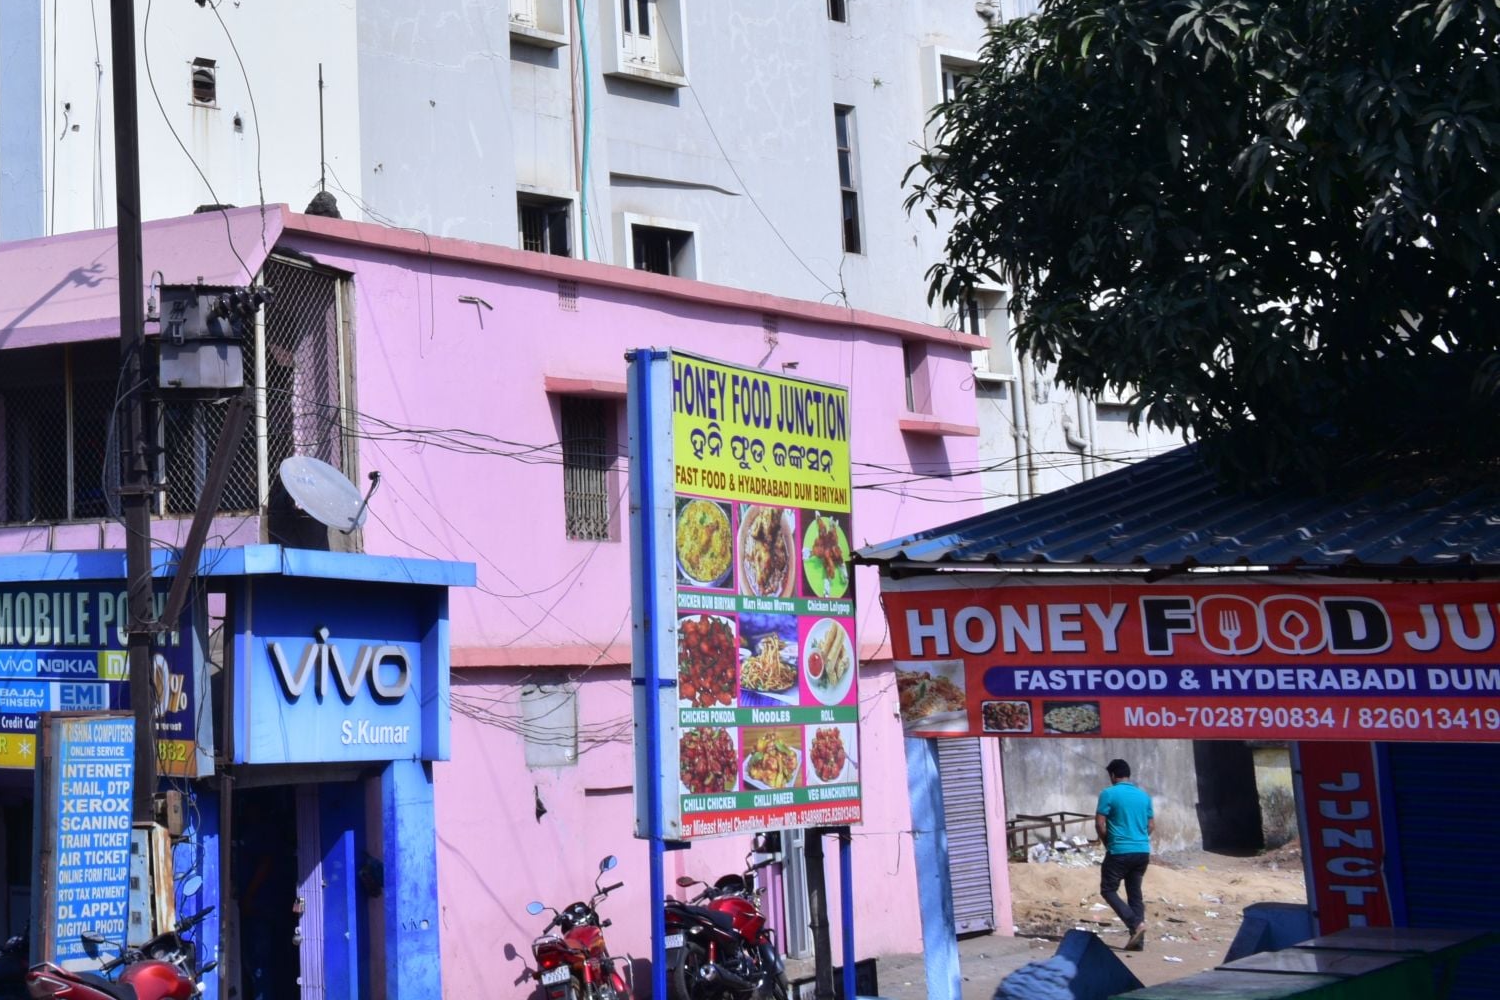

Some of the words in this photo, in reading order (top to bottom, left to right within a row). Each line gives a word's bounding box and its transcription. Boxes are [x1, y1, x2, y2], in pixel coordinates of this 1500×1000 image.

[671, 360, 727, 422] HONEY
[731, 373, 772, 430] FOOD
[777, 383, 847, 442] JUNCTION
[675, 464, 699, 487] FAST
[701, 468, 727, 491] FOOD
[728, 473, 736, 492] &
[738, 475, 792, 500] HYADRABADI
[794, 482, 812, 501] DUM
[813, 485, 847, 505] BIRIYANI
[677, 594, 701, 608] CHICKEN
[807, 600, 829, 612] Chicken
[904, 601, 1129, 658] HONEY
[1139, 594, 1393, 656] FOOD
[0, 656, 33, 672] vivo
[36, 658, 97, 674] NOKIA
[268, 626, 412, 698] vivo
[1013, 668, 1169, 691] FASTFOOD
[1178, 668, 1201, 691] &
[1209, 668, 1418, 691] HYDERABADI
[1427, 668, 1500, 691] DUM
[0, 688, 45, 698] BAJAJ
[60, 685, 102, 705] EMI
[0, 698, 45, 708] FINSERV
[1, 717, 24, 729] Credit
[681, 709, 709, 723] CHICKEN
[710, 709, 736, 723] POKODA
[820, 709, 835, 722] ROLL
[1124, 705, 1336, 730] Mob-7028790834
[93, 723, 134, 743] COMPUTERS
[341, 719, 411, 746] S.Kumar
[70, 746, 95, 757] ONLINE
[96, 746, 125, 757] SERVICE
[62, 763, 132, 779] INTERNET
[61, 781, 105, 799] E-MAIL,
[107, 780, 130, 796] DTP
[807, 788, 820, 801] VEG
[62, 798, 130, 813] XEROX
[683, 797, 706, 812] CHILLI
[707, 796, 737, 810] CHICKEN
[753, 793, 772, 808] CHILLI
[773, 791, 794, 806] PANEER
[60, 815, 129, 832] SCANING
[682, 823, 693, 837] ear
[693, 817, 717, 836] Mideast
[717, 816, 733, 834] Hotel
[60, 834, 91, 849] TRAIN
[92, 832, 128, 848] TICKET
[59, 851, 81, 867] AIR
[83, 850, 128, 866] TICKET
[58, 869, 84, 885] ONLINE
[84, 868, 102, 882] FORM
[103, 866, 127, 881] FILL-UP
[58, 888, 74, 902] RTO
[76, 887, 91, 900] TAX
[91, 886, 126, 900] PAYMENT
[58, 904, 77, 920] DL
[81, 901, 127, 918] APPLY
[57, 921, 91, 938] DIGITAL
[94, 918, 125, 935] PHOTO
